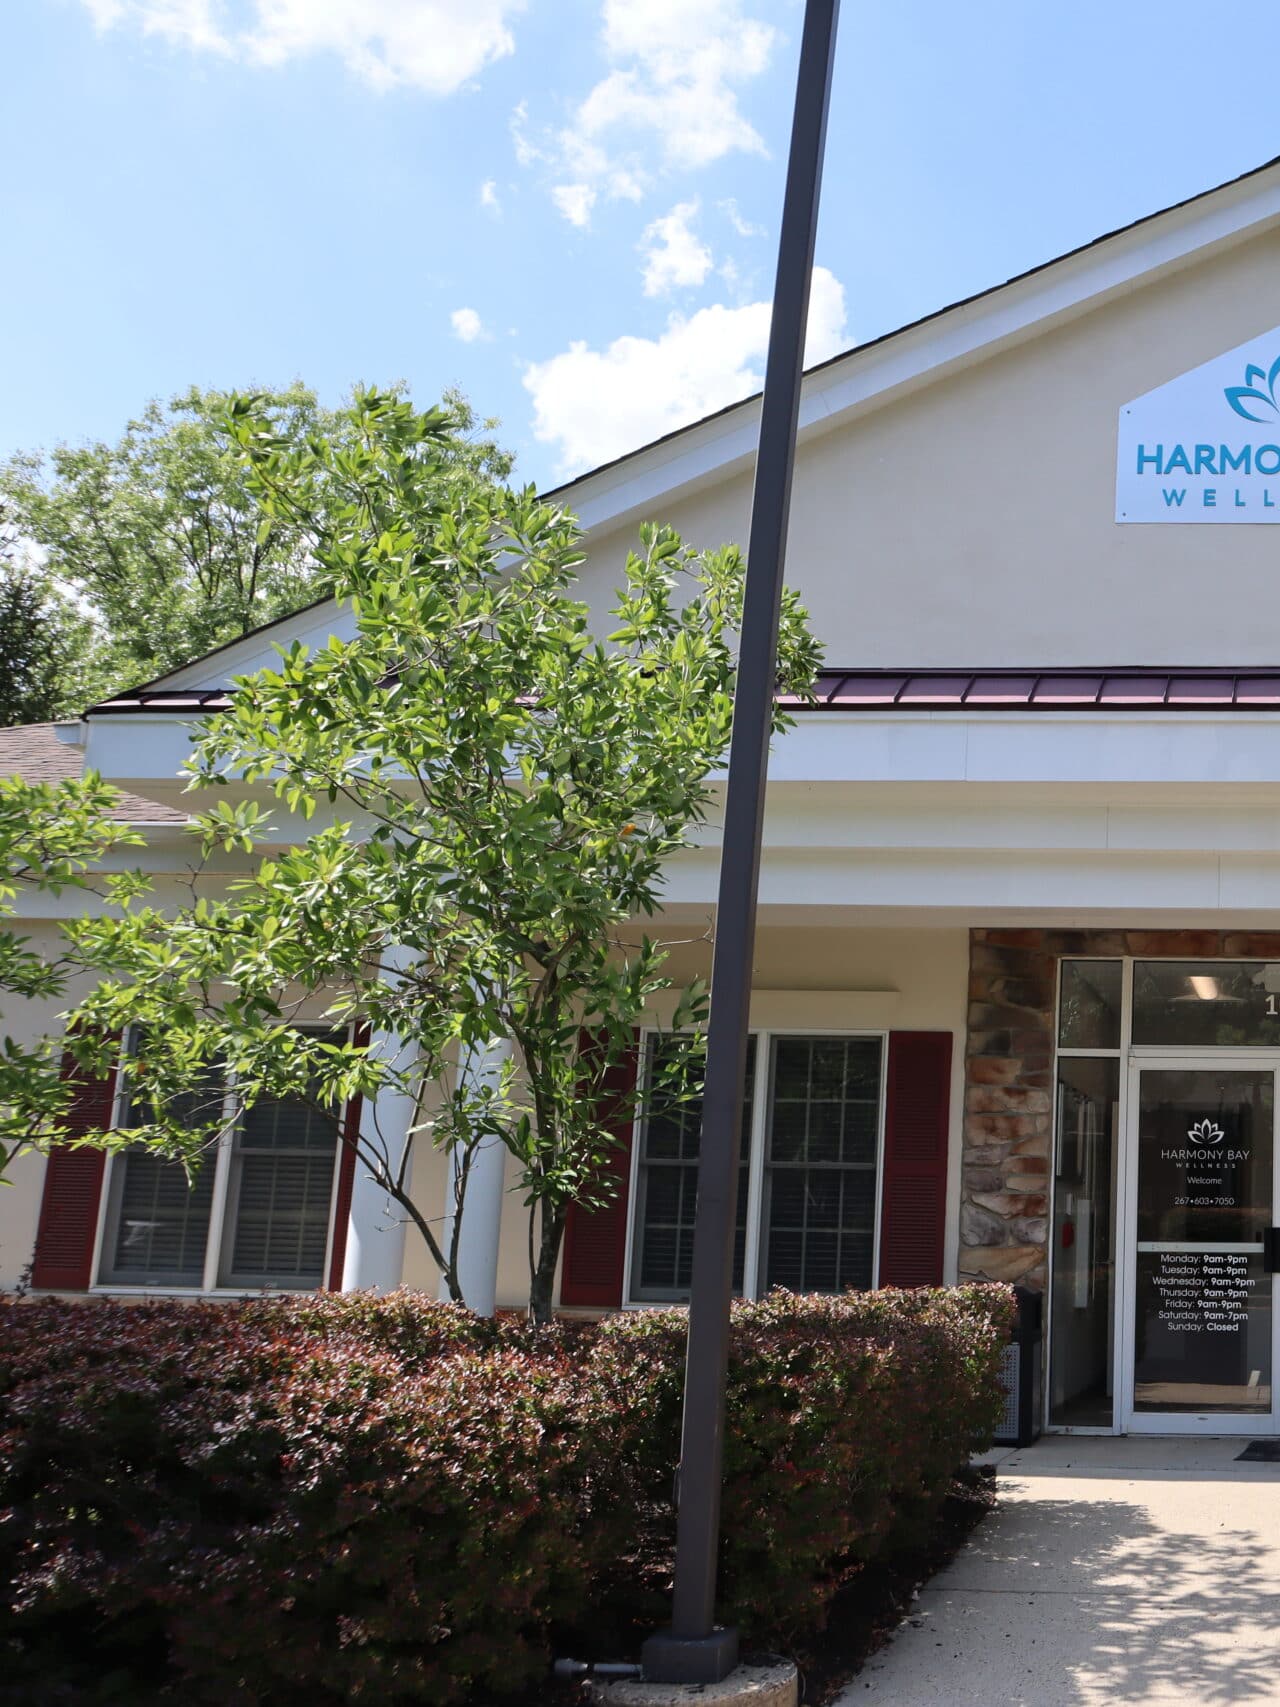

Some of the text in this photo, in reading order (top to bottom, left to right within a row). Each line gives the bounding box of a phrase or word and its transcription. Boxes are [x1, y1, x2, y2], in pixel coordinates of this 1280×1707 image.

[1161, 1149, 1250, 1160] HARMONY BAY
[1186, 1176, 1223, 1185] Welcome
[1160, 1254, 1248, 1265] Monday: 9am-9pm
[1161, 1265, 1247, 1276] Tuesday: 9am-9pm
[1152, 1276, 1256, 1287] Wednesday: 9am-9pm
[1160, 1287, 1248, 1298] Thursday: 9am-9pm
[1165, 1299, 1242, 1310] Friday: 9am-9pm
[1158, 1310, 1249, 1321] Saturday: 9am-7pm
[1167, 1322, 1239, 1331] Sunday: Closed
